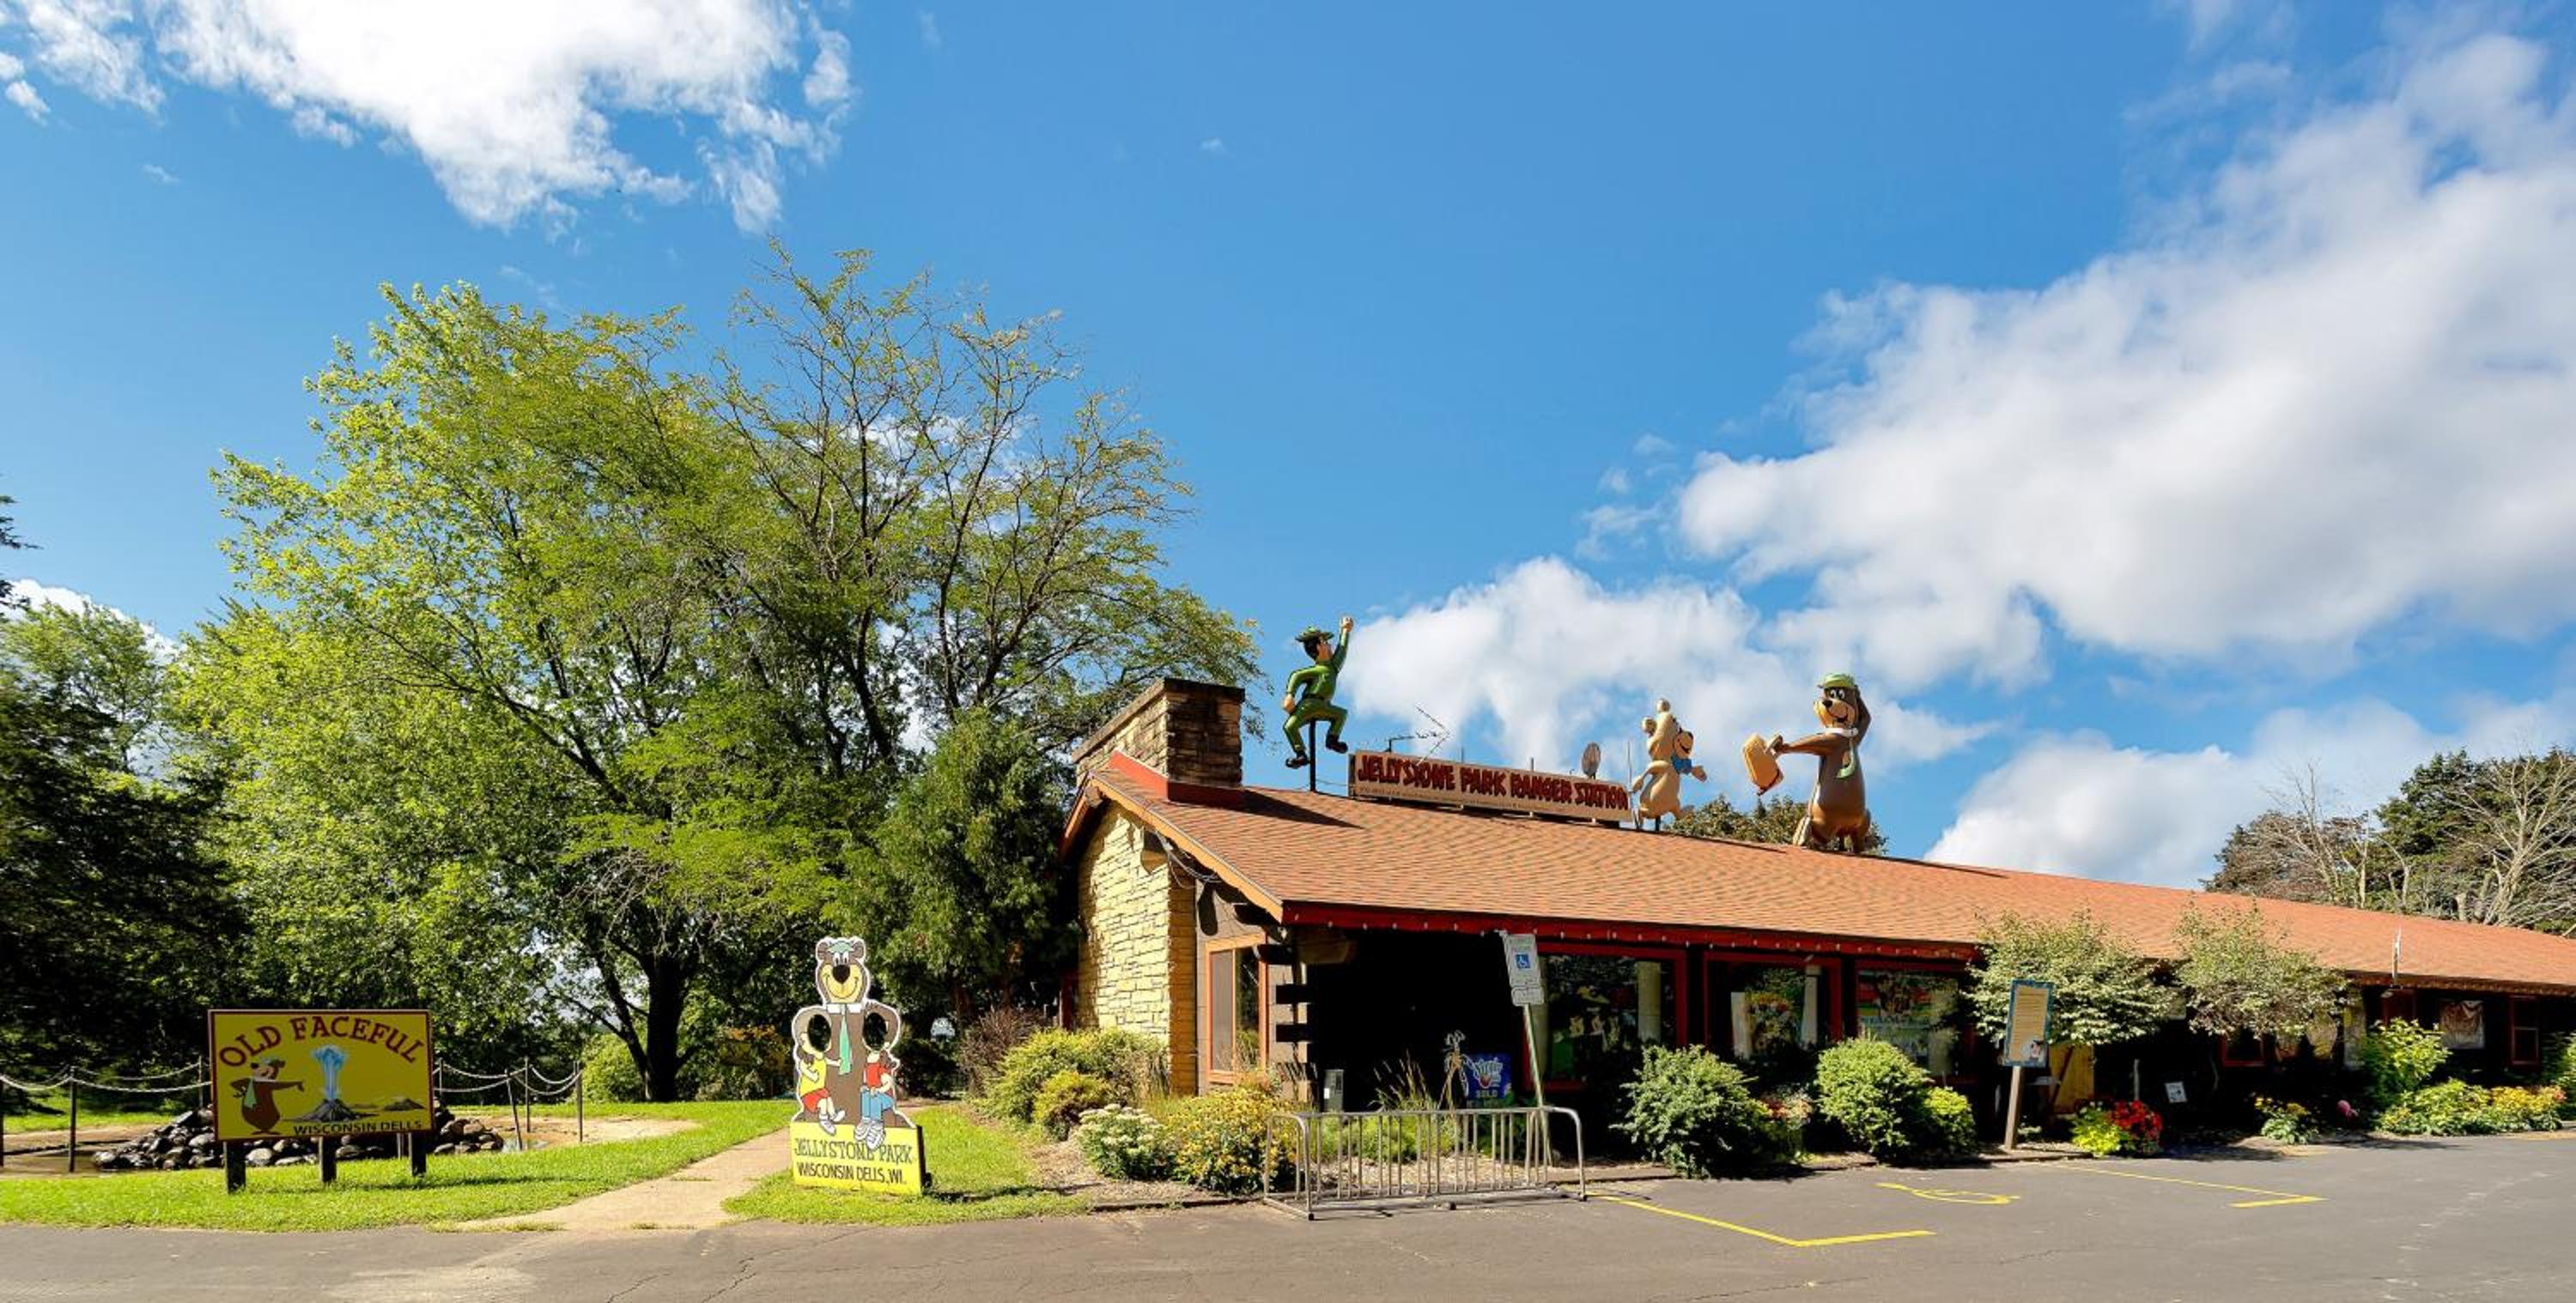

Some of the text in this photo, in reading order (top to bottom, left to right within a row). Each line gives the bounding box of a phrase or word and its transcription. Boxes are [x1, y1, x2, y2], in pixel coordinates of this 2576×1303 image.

[1358, 755, 1629, 810] JELLYSTONE PARK RANGER STATION
[219, 1016, 424, 1067] OLD FACEFUL
[293, 1119, 422, 1136] WISCONSIN DELLS
[794, 1137, 913, 1164] JELLYSTONE PARK
[797, 1162, 854, 1179] WISCONSIN
